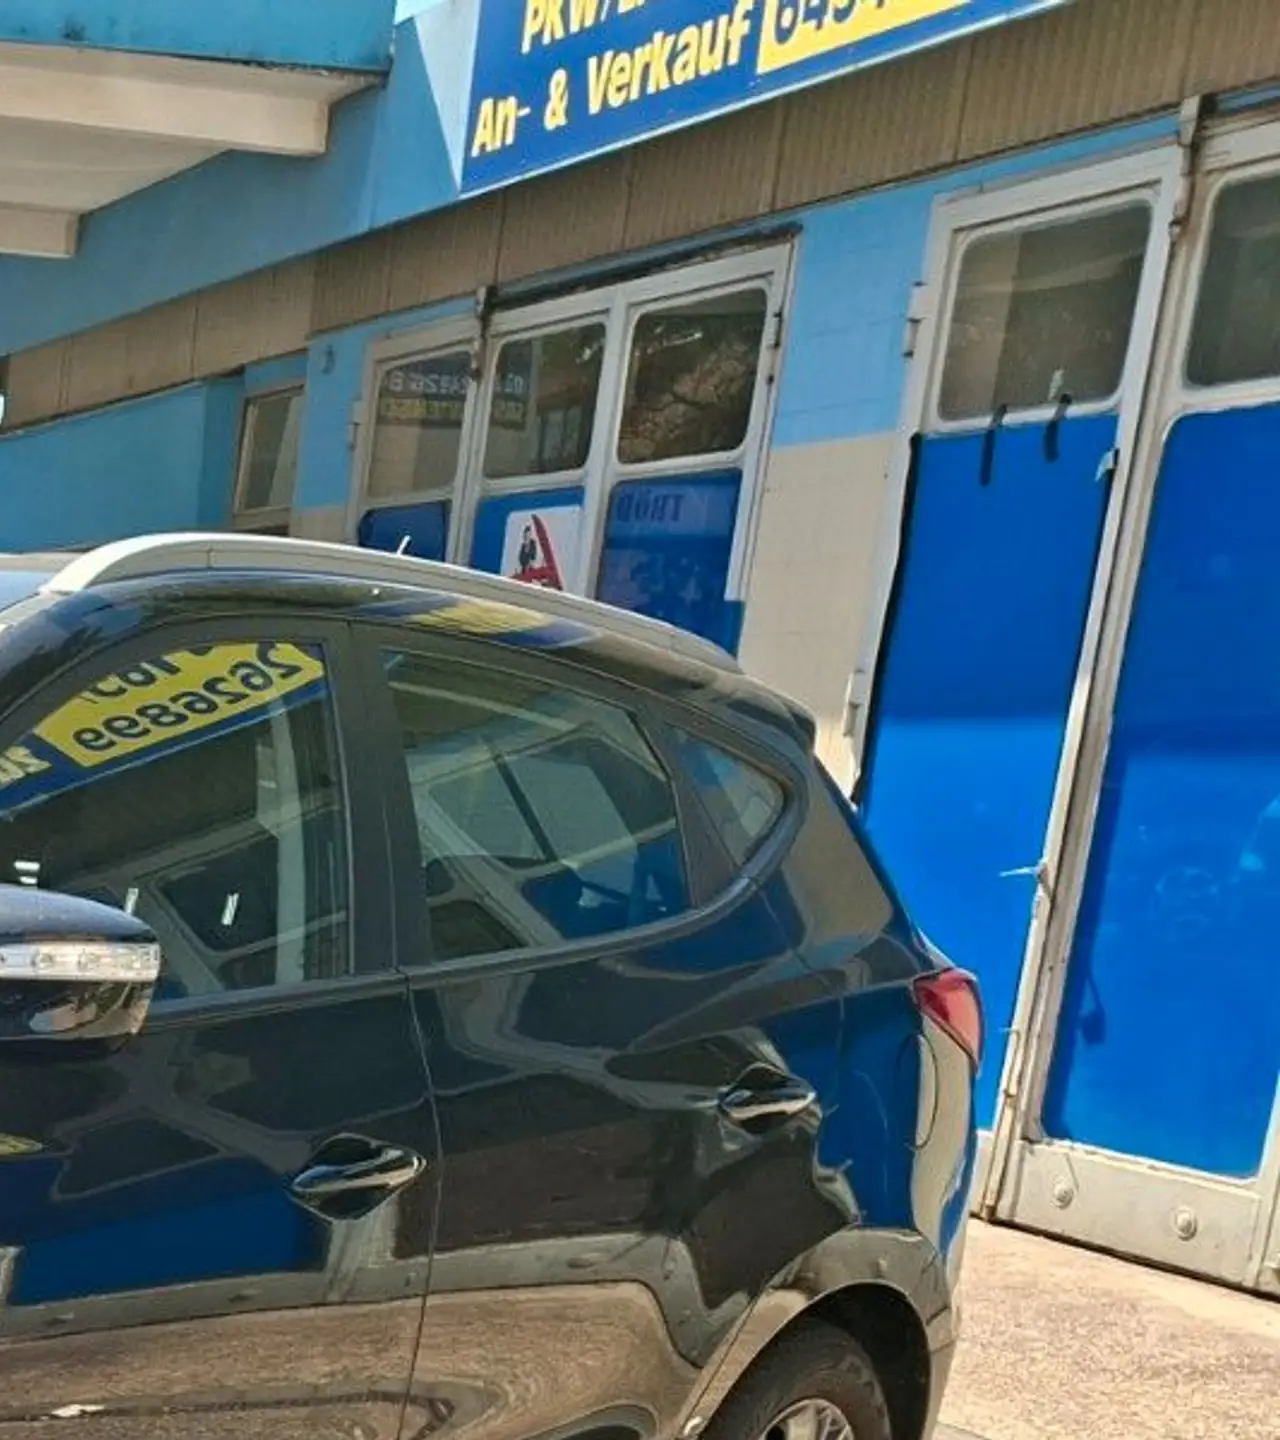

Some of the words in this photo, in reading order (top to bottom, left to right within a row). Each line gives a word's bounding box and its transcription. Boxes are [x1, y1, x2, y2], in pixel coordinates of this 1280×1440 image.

[472, 92, 529, 157] An-
[544, 70, 568, 129] &
[587, 7, 749, 115] Verkauf
